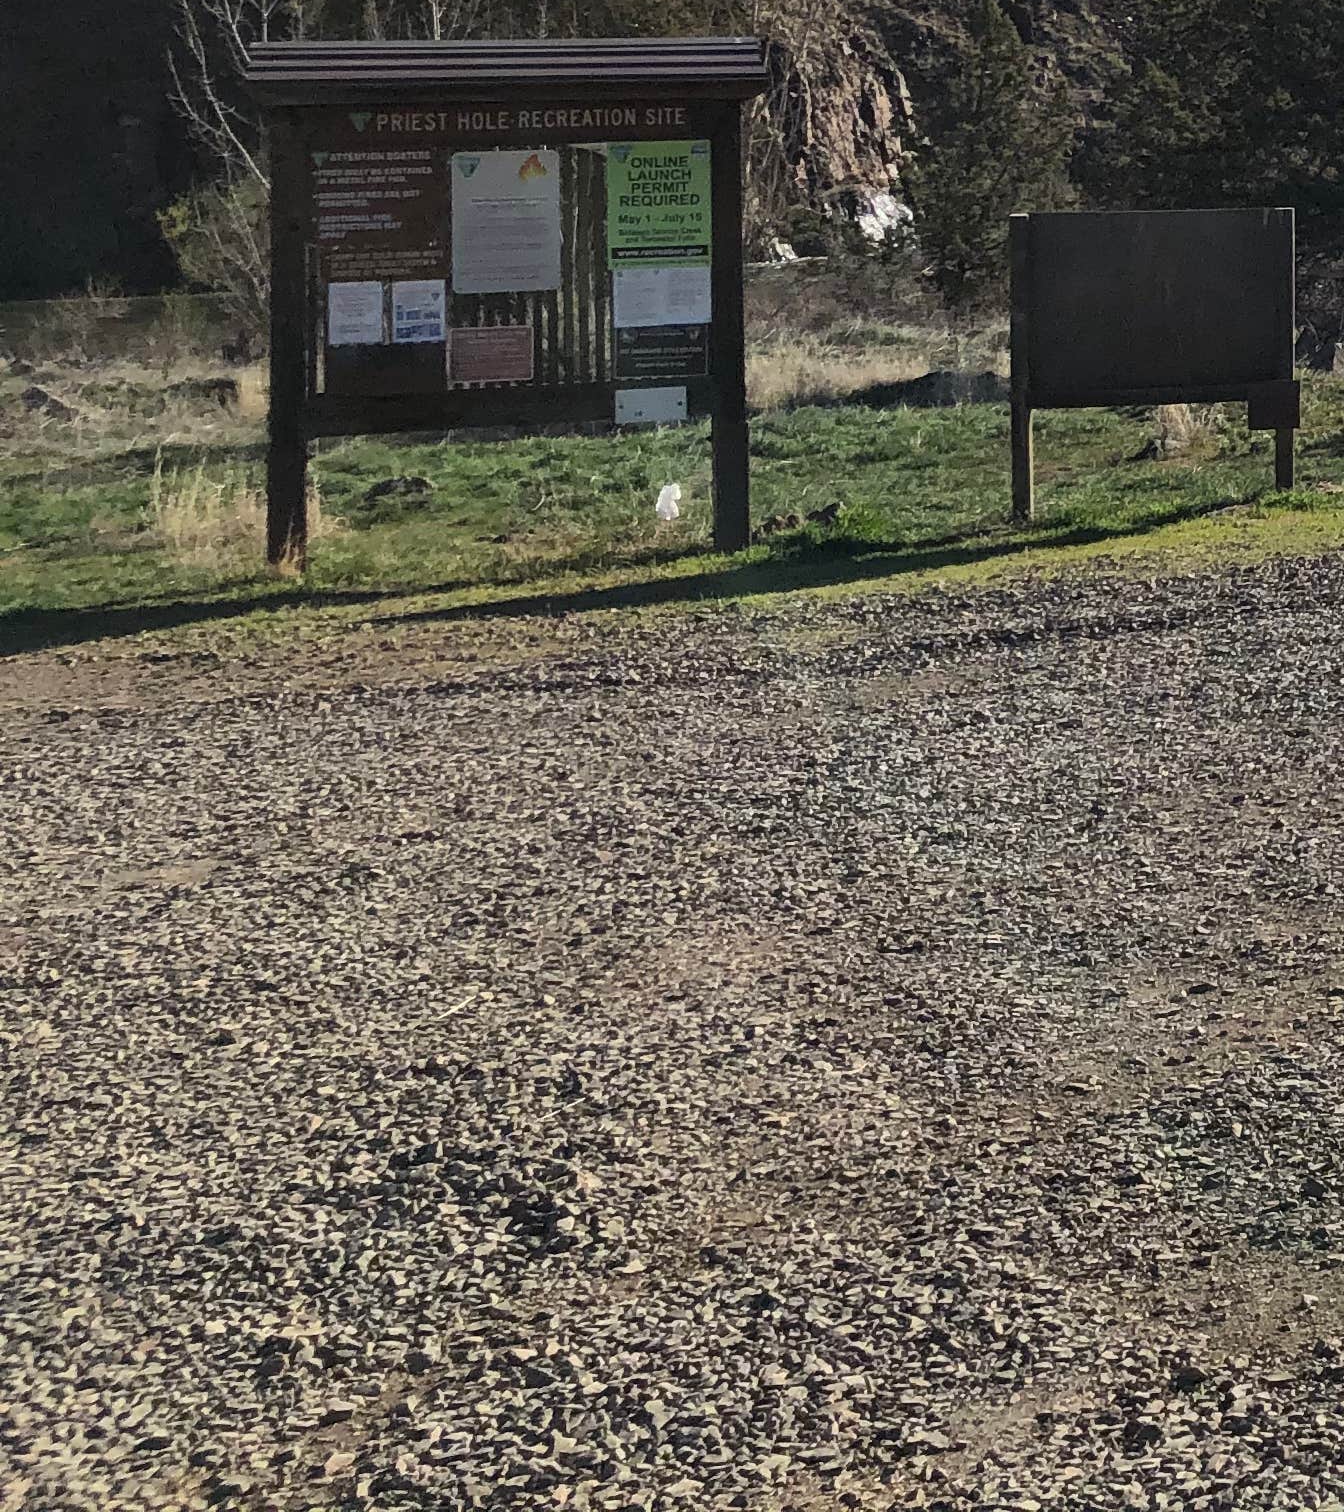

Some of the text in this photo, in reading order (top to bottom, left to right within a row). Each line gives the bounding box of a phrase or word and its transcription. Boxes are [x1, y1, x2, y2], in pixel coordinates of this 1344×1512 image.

[377, 108, 687, 132] PRIEST HOLE RECREATION SITE
[631, 156, 688, 168] ONLINE
[628, 169, 691, 181] LAUNCH
[632, 182, 688, 194] PERMIT
[620, 194, 700, 207] REQUIRED
[618, 215, 641, 224] May
[645, 214, 651, 222] 1
[661, 214, 685, 224] July
